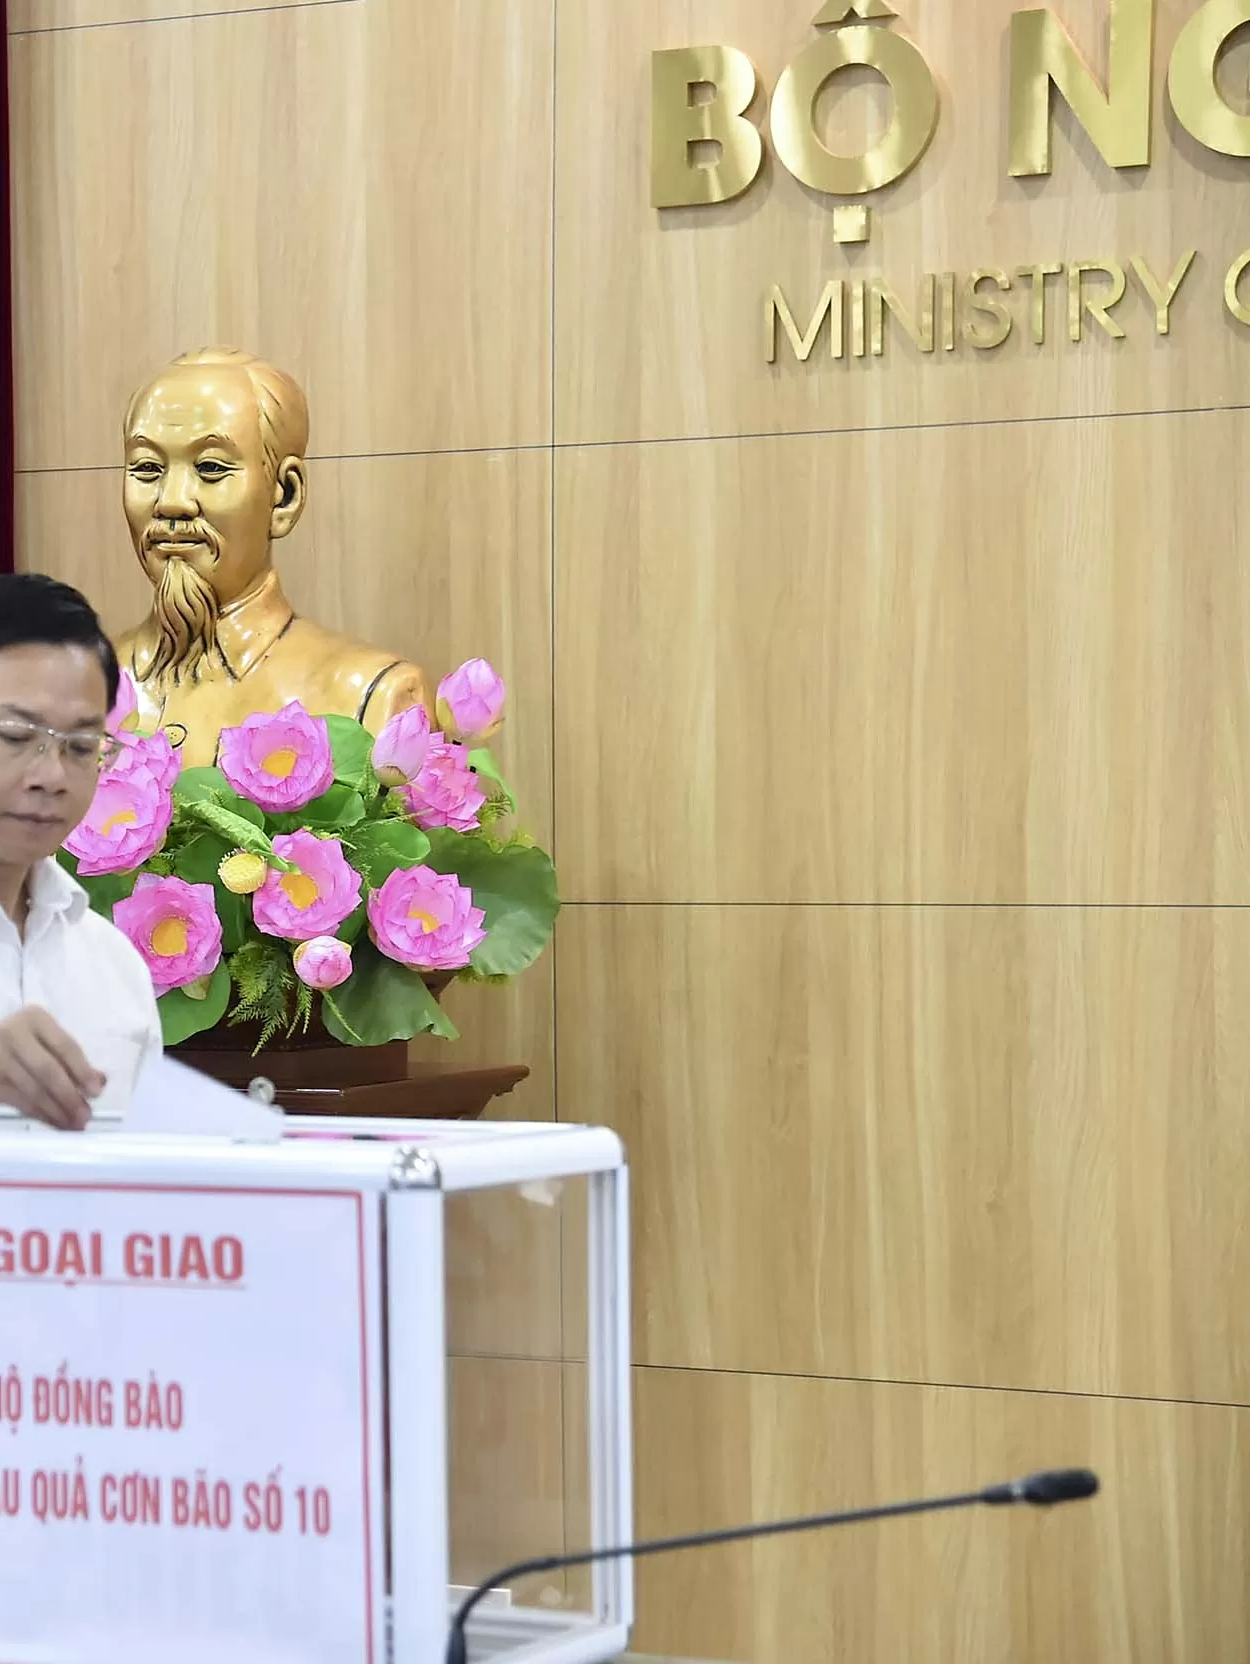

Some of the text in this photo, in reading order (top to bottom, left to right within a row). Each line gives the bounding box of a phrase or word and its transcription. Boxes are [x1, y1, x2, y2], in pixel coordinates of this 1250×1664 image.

[651, 0, 939, 243] BỘ
[765, 249, 1197, 363] MINISTRY
[123, 1232, 244, 1283] GIAO
[123, 1368, 184, 1431] BÀO
[31, 1453, 89, 1525] QUẢ
[99, 1468, 161, 1525] CƠN
[172, 1468, 232, 1530] BÃO
[243, 1463, 284, 1533] SỐ
[294, 1485, 331, 1536] 10
